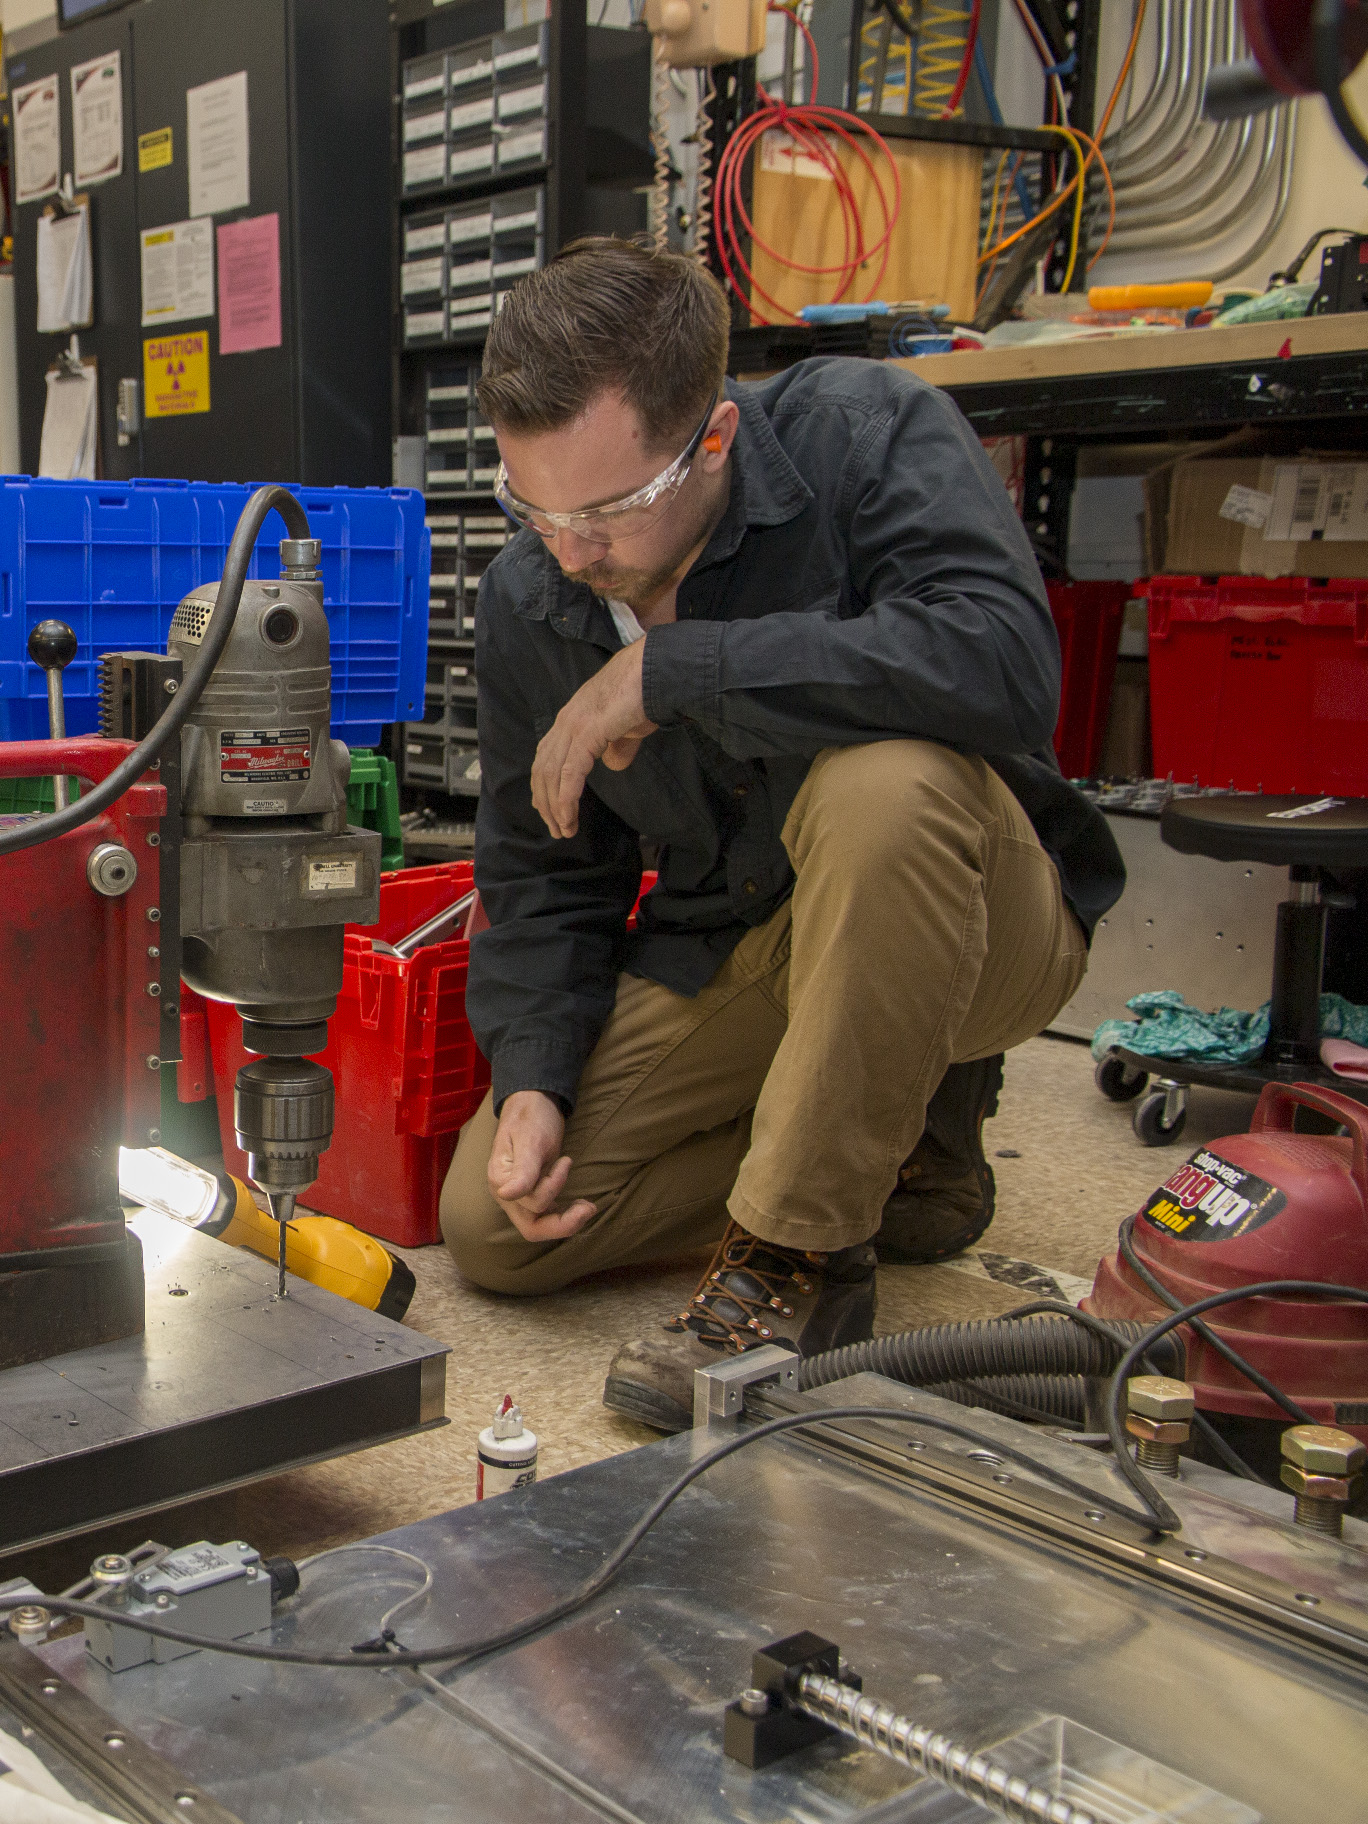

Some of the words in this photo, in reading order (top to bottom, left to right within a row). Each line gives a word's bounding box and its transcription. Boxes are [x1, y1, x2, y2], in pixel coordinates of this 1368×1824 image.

[149, 338, 203, 361] CAUTION
[248, 754, 285, 768] Milwaukee
[1148, 1199, 1196, 1233] Mini
